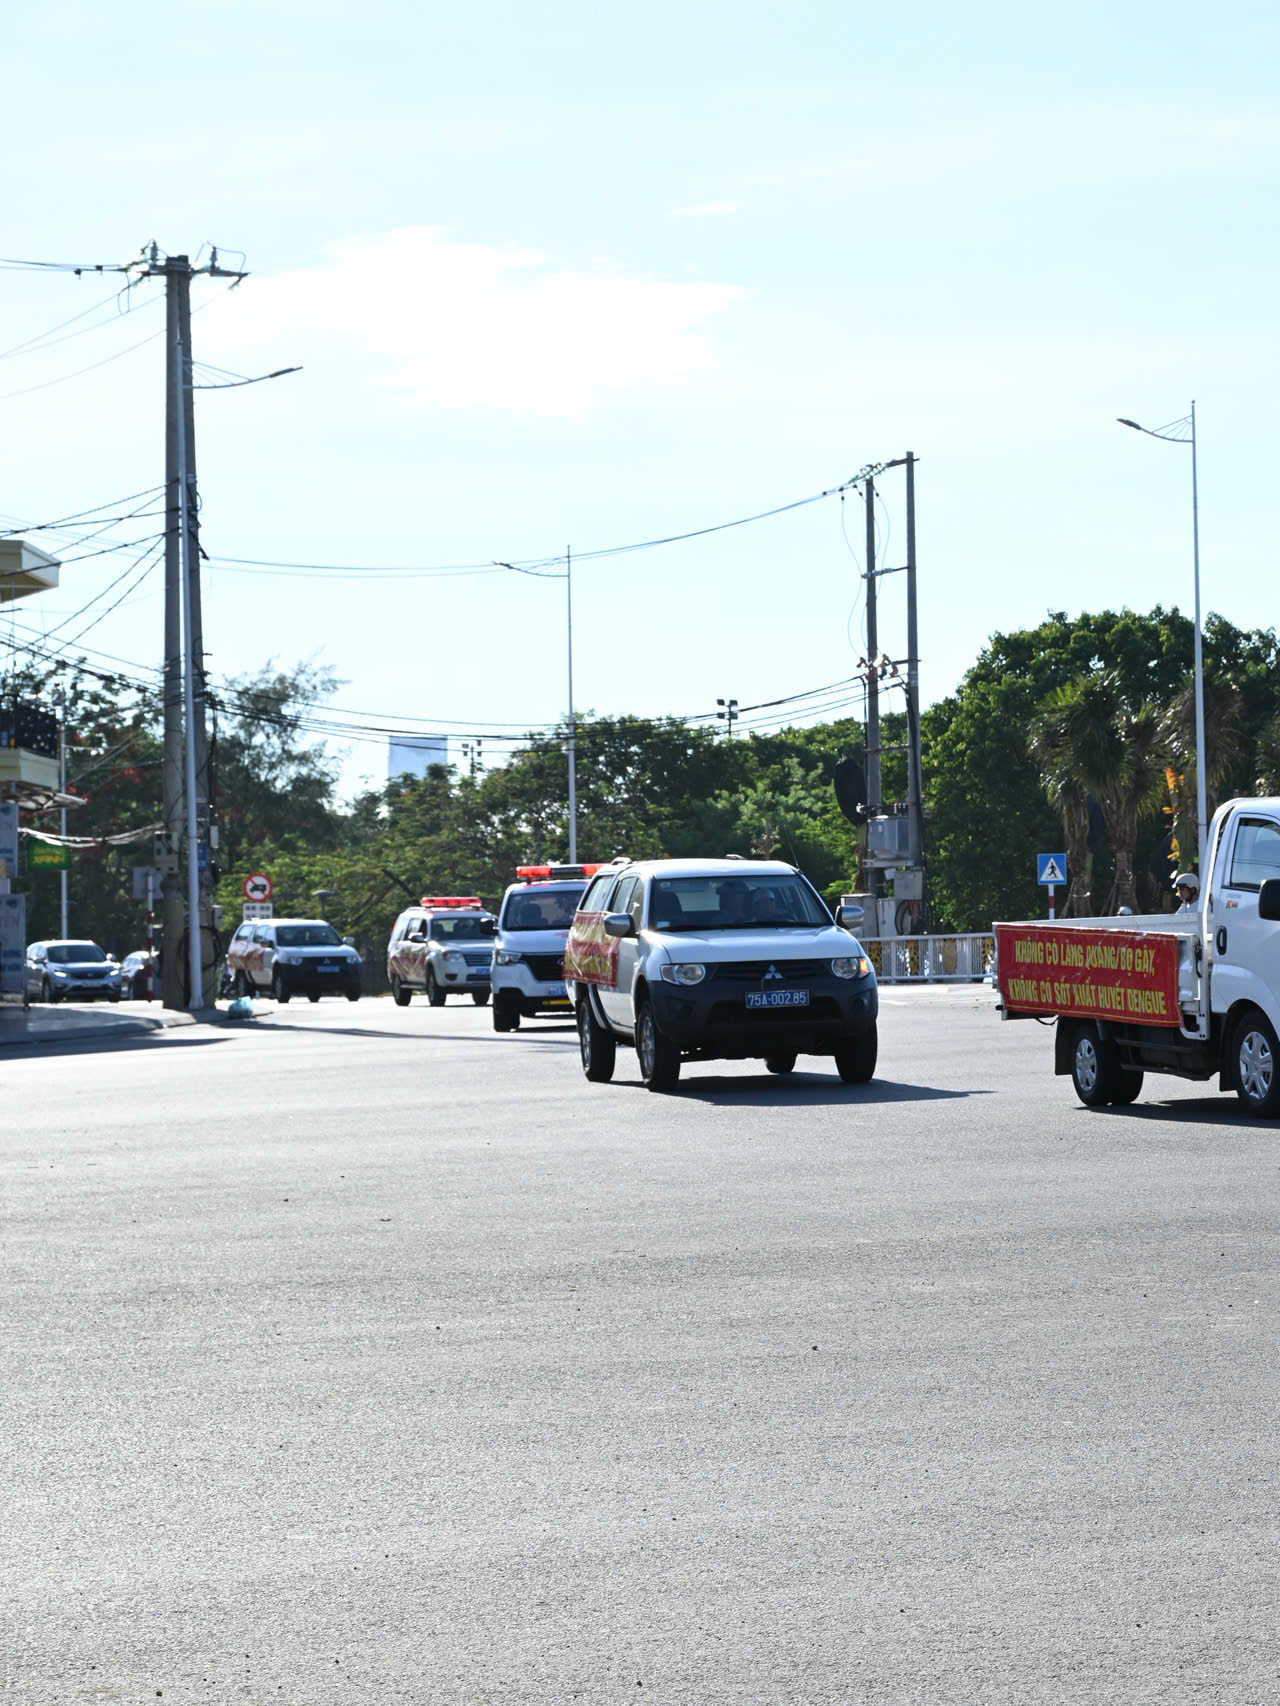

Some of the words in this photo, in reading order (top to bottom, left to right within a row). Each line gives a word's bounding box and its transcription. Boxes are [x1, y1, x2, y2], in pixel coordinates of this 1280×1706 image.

[1015, 937, 1044, 963] KHÔNG
[1046, 938, 1058, 965] CÓ
[1008, 975, 1038, 1002] KHÔNG
[1040, 978, 1053, 1003] CÓ
[1054, 976, 1071, 1005] SỐT
[1072, 977, 1097, 1008] XUẤT
[1098, 980, 1125, 1011] HUYẾT
[1127, 988, 1167, 1015] DENGUE
